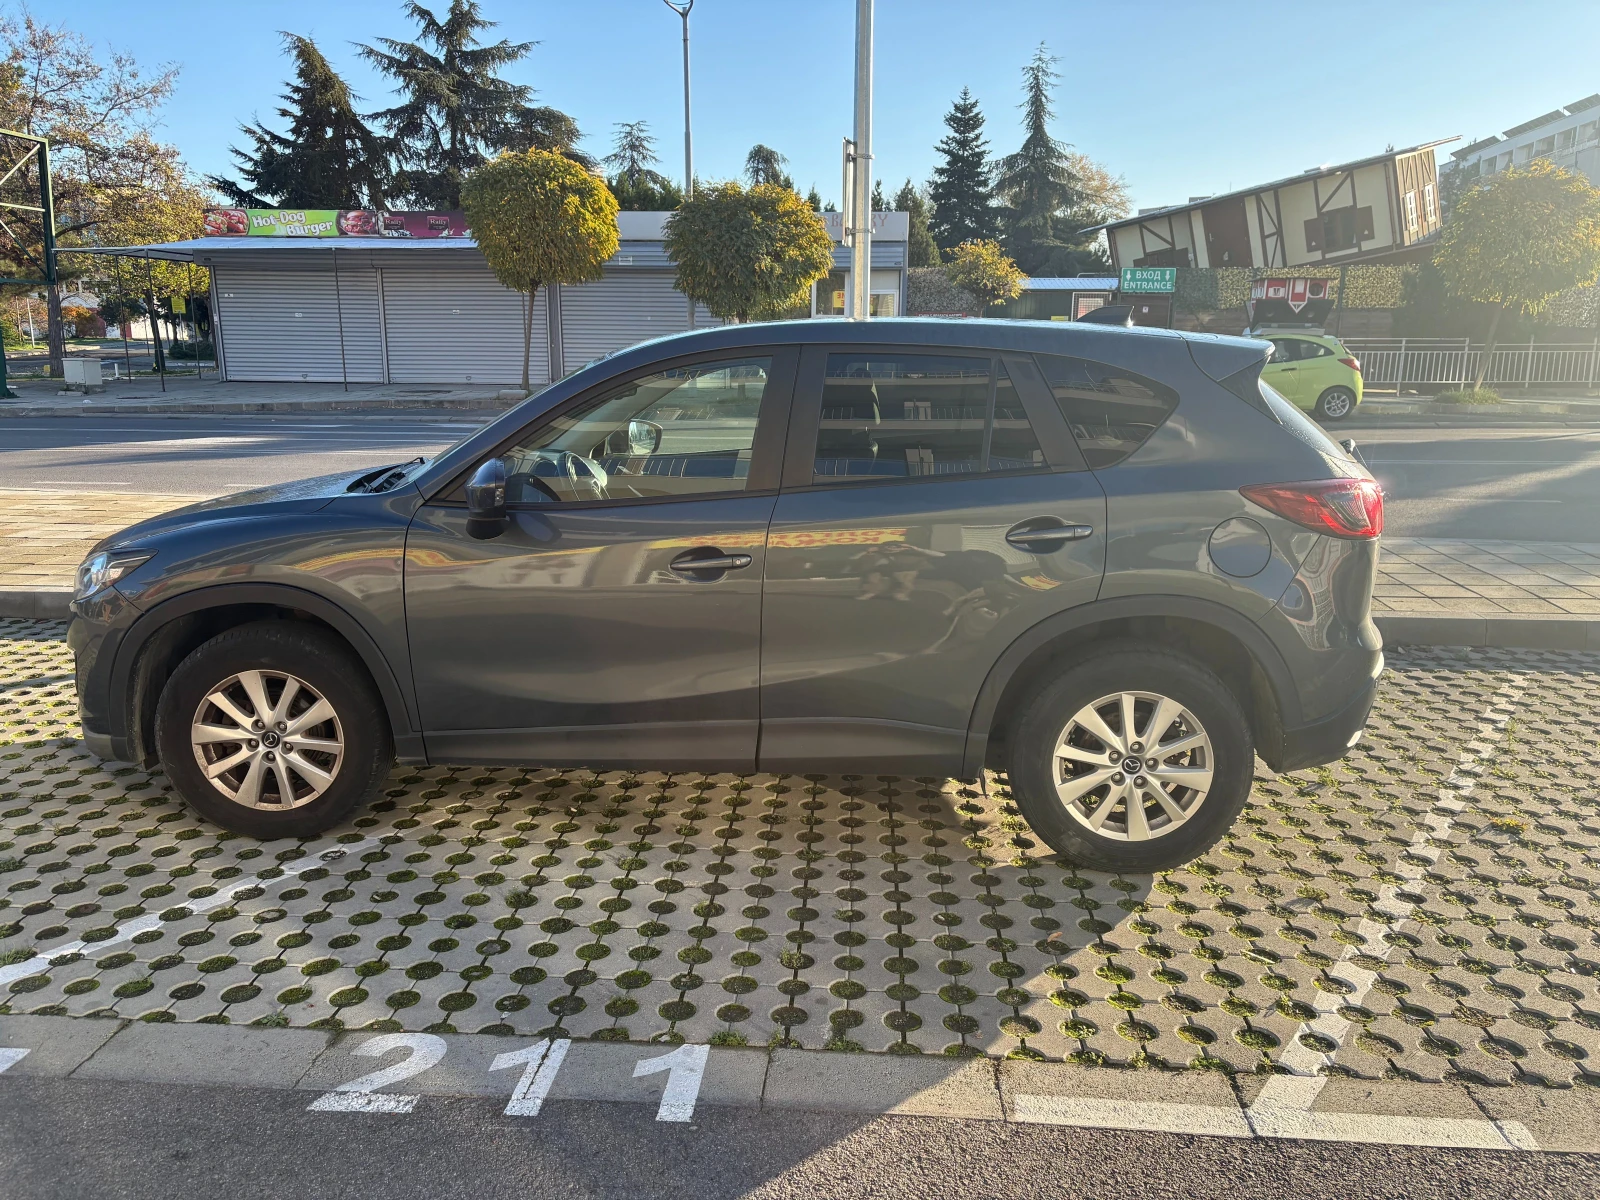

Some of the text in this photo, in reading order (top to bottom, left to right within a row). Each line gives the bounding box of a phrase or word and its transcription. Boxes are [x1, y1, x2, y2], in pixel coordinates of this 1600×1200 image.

[252, 211, 306, 228] Hot-Dog
[286, 221, 333, 236] Burger
[1136, 270, 1161, 281] ВХОД
[1124, 281, 1172, 289] ENTRANCE
